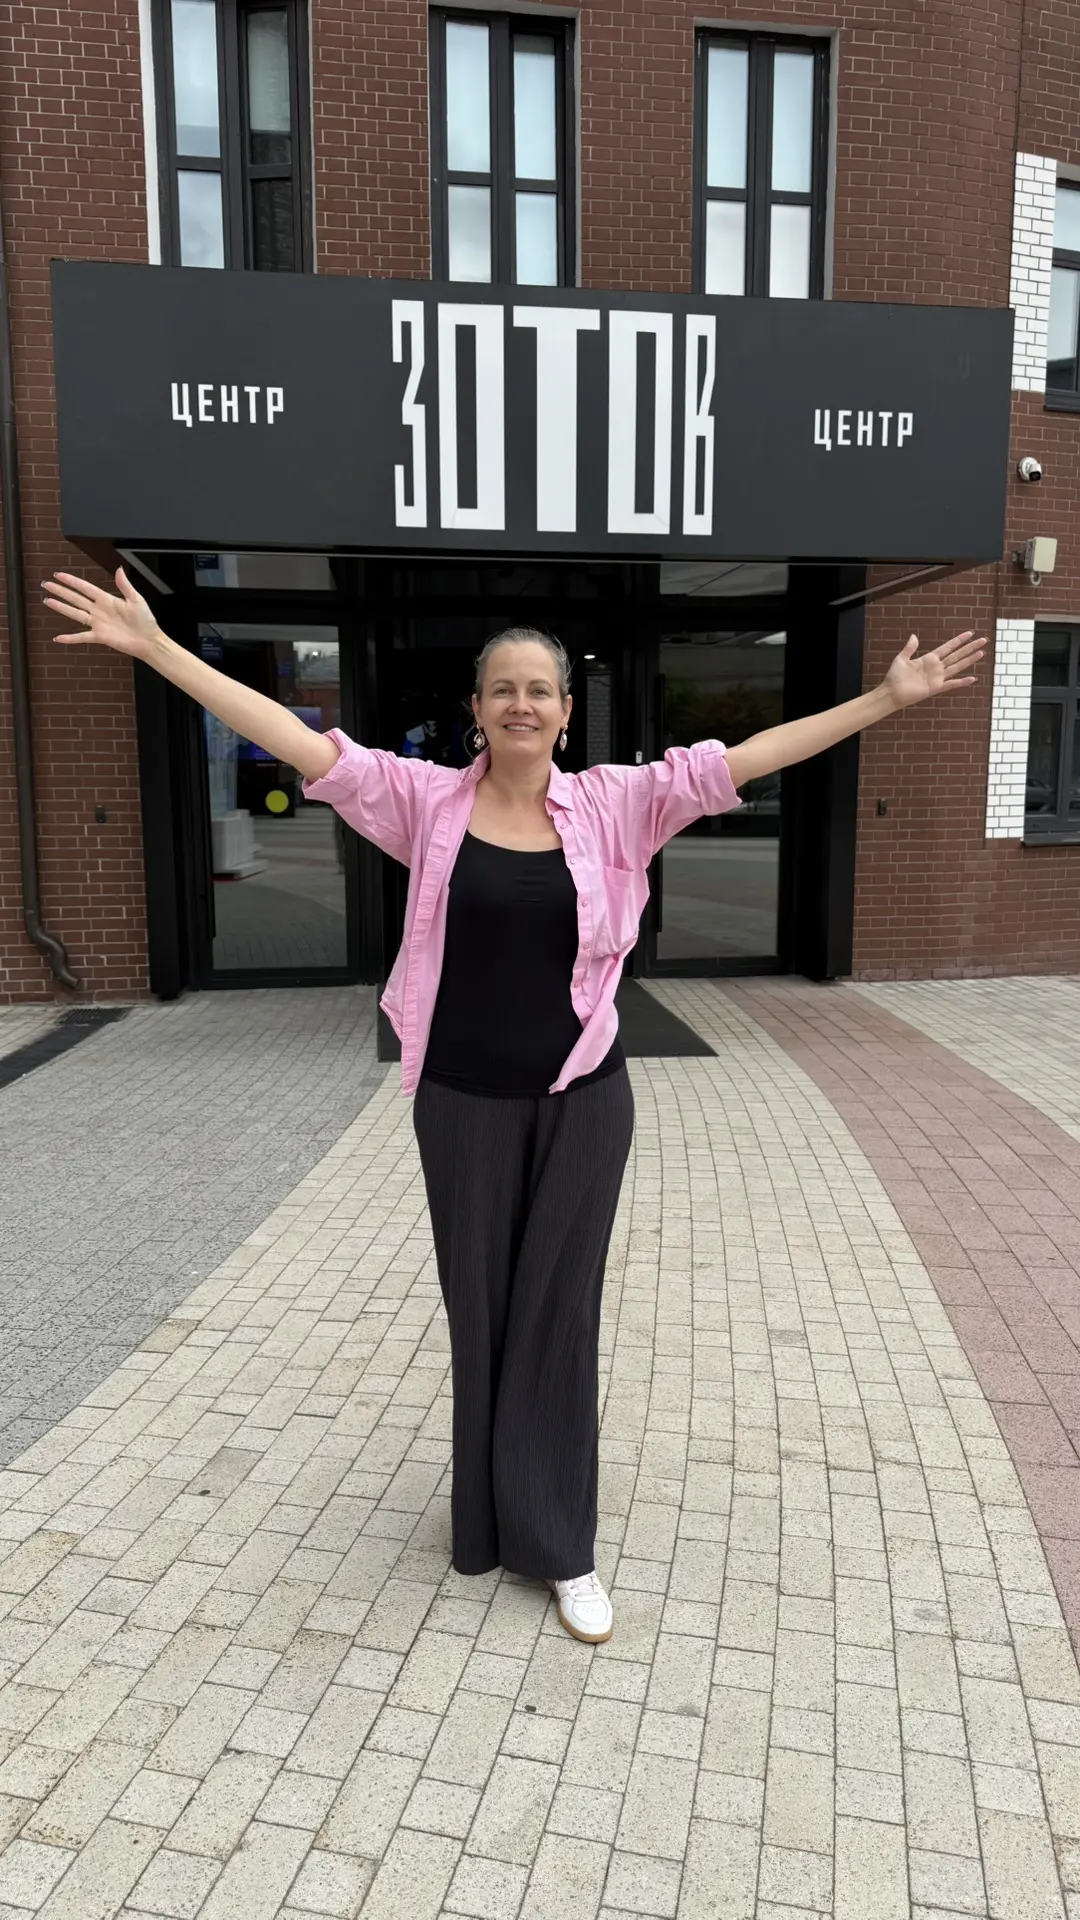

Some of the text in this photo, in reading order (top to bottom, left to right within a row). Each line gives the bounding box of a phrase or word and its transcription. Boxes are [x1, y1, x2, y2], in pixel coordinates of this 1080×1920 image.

[171, 382, 284, 428] ЦЕНТР
[391, 299, 717, 536] ЗОТОВ
[813, 408, 914, 452] ЦЕНТР
